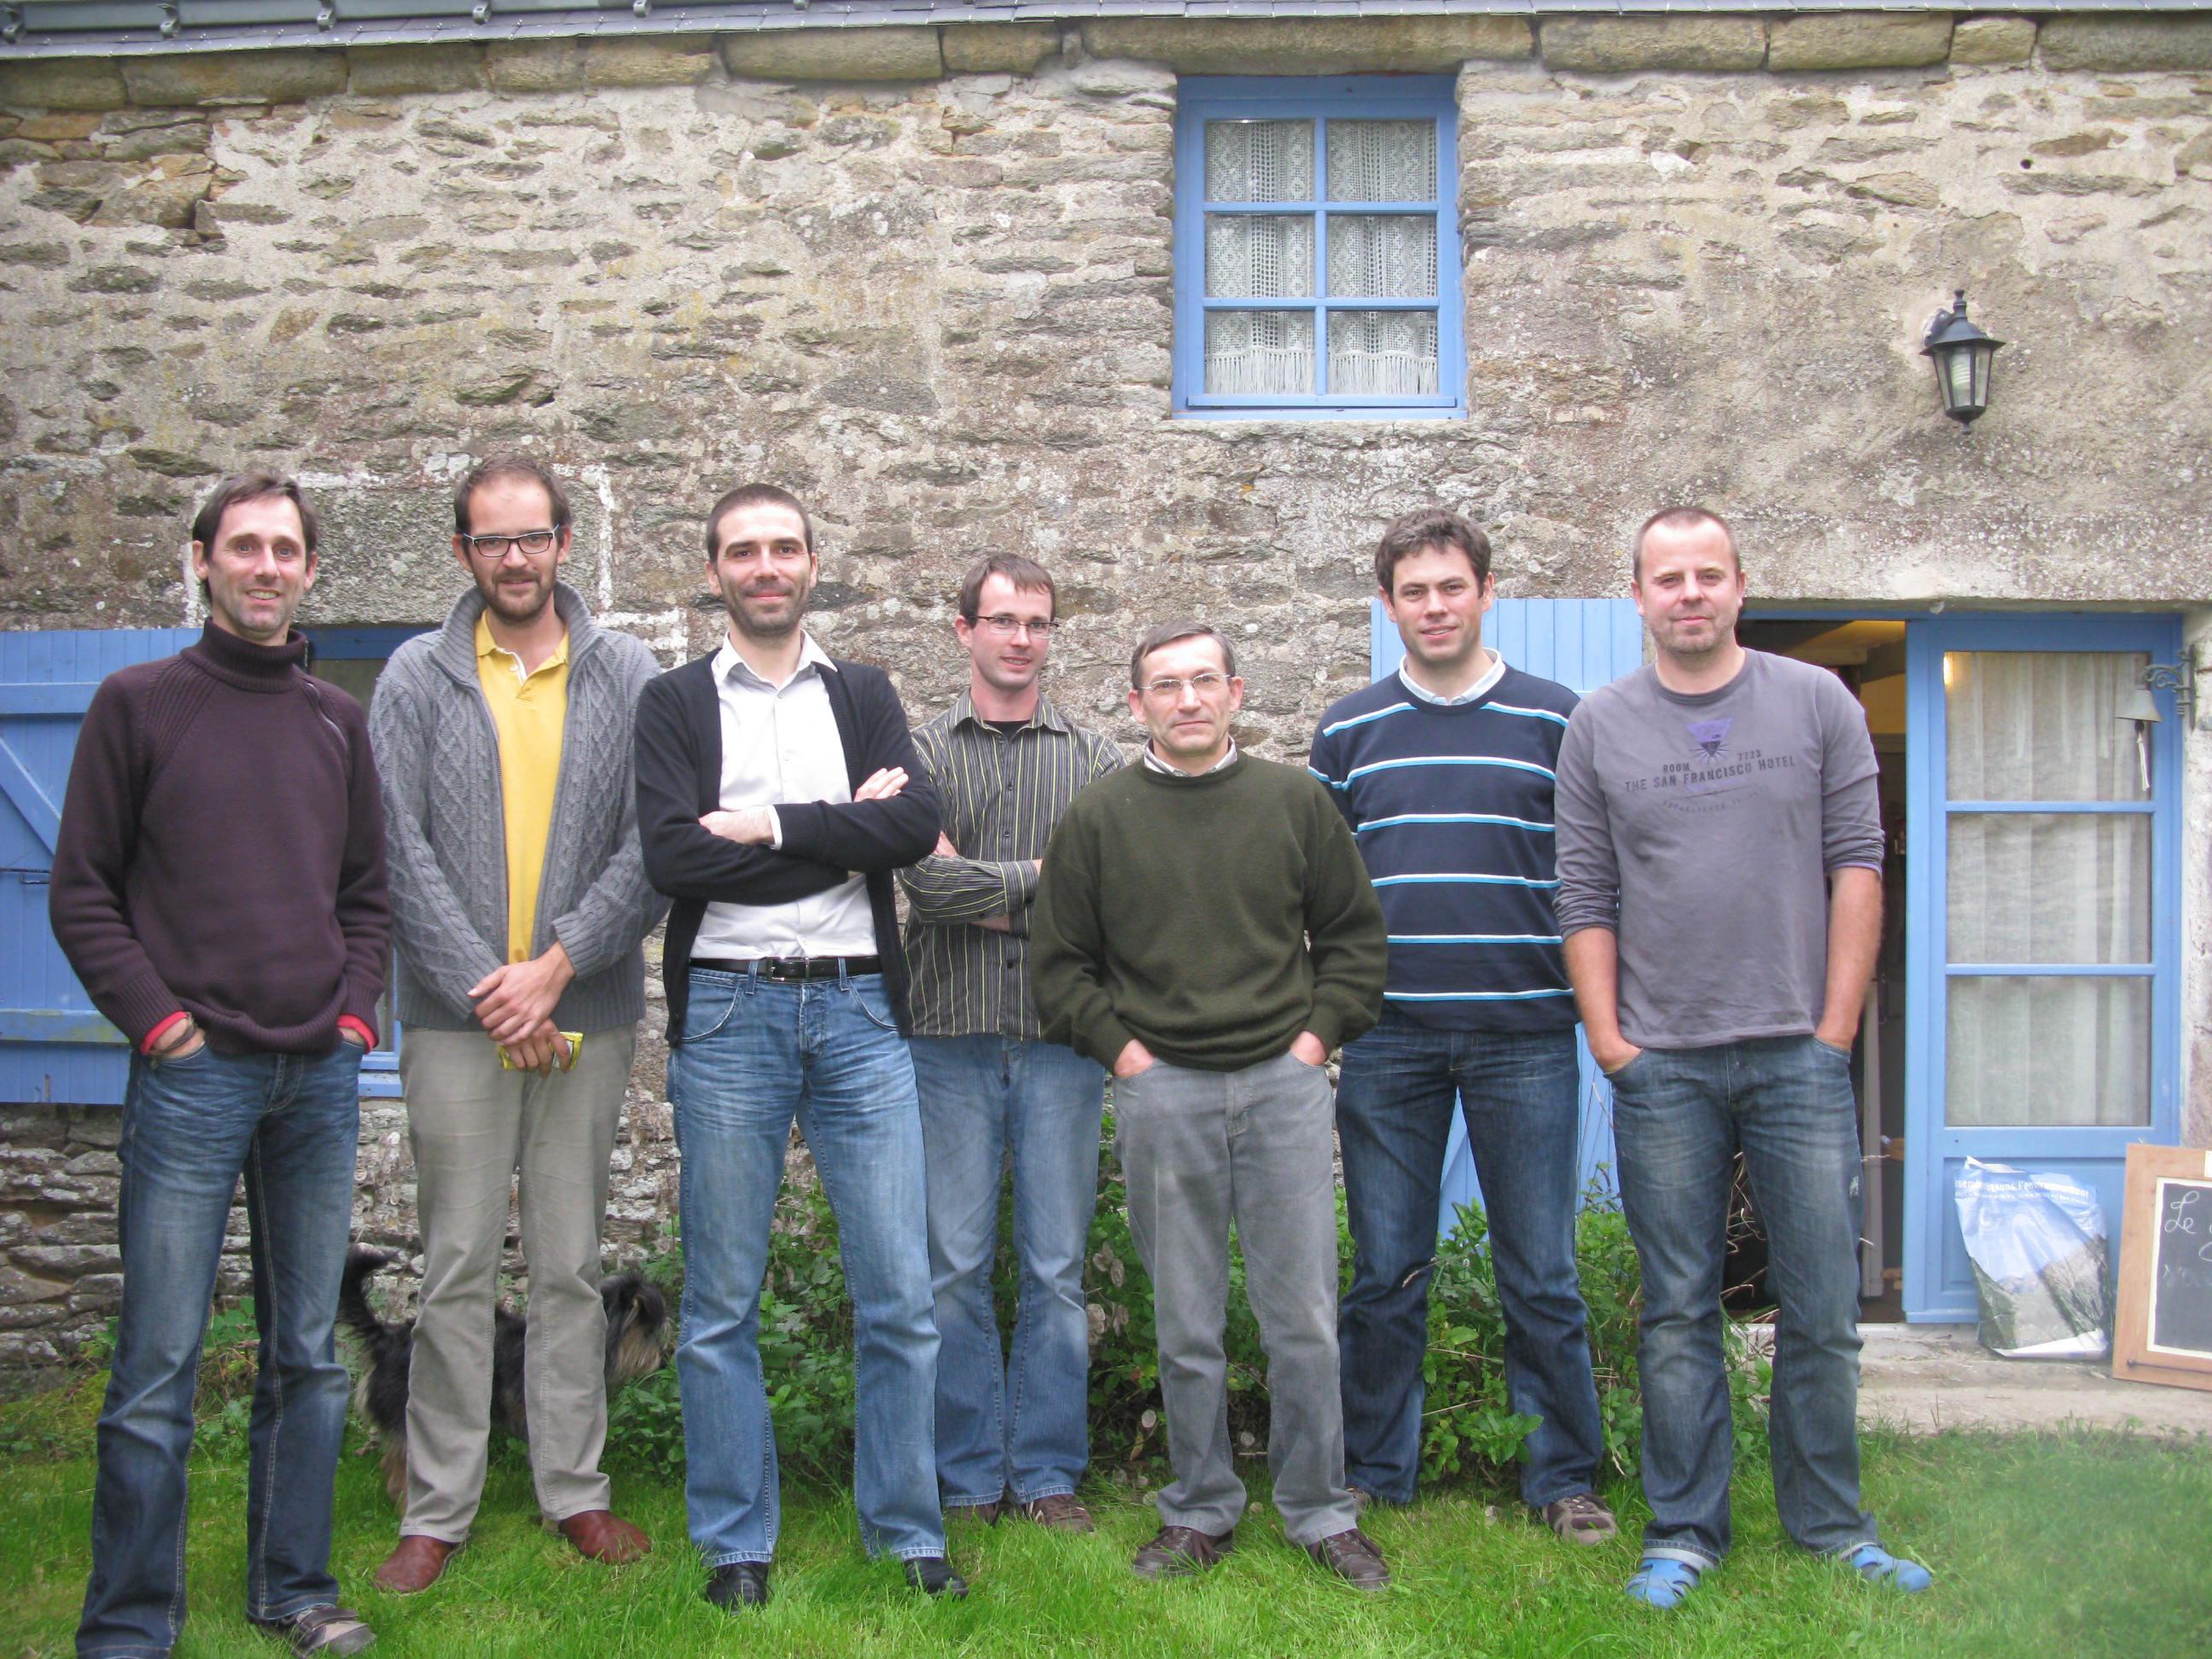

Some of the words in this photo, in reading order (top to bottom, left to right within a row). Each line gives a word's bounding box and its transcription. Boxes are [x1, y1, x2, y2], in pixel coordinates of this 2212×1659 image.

[1625, 779, 1647, 792] THE
[1653, 775, 1676, 788] SAN
[1684, 763, 1752, 784] FRANCISCO
[1758, 755, 1796, 771] HOTEL
[1662, 762, 1690, 773] ROOM
[2164, 1190, 2198, 1234] Le
